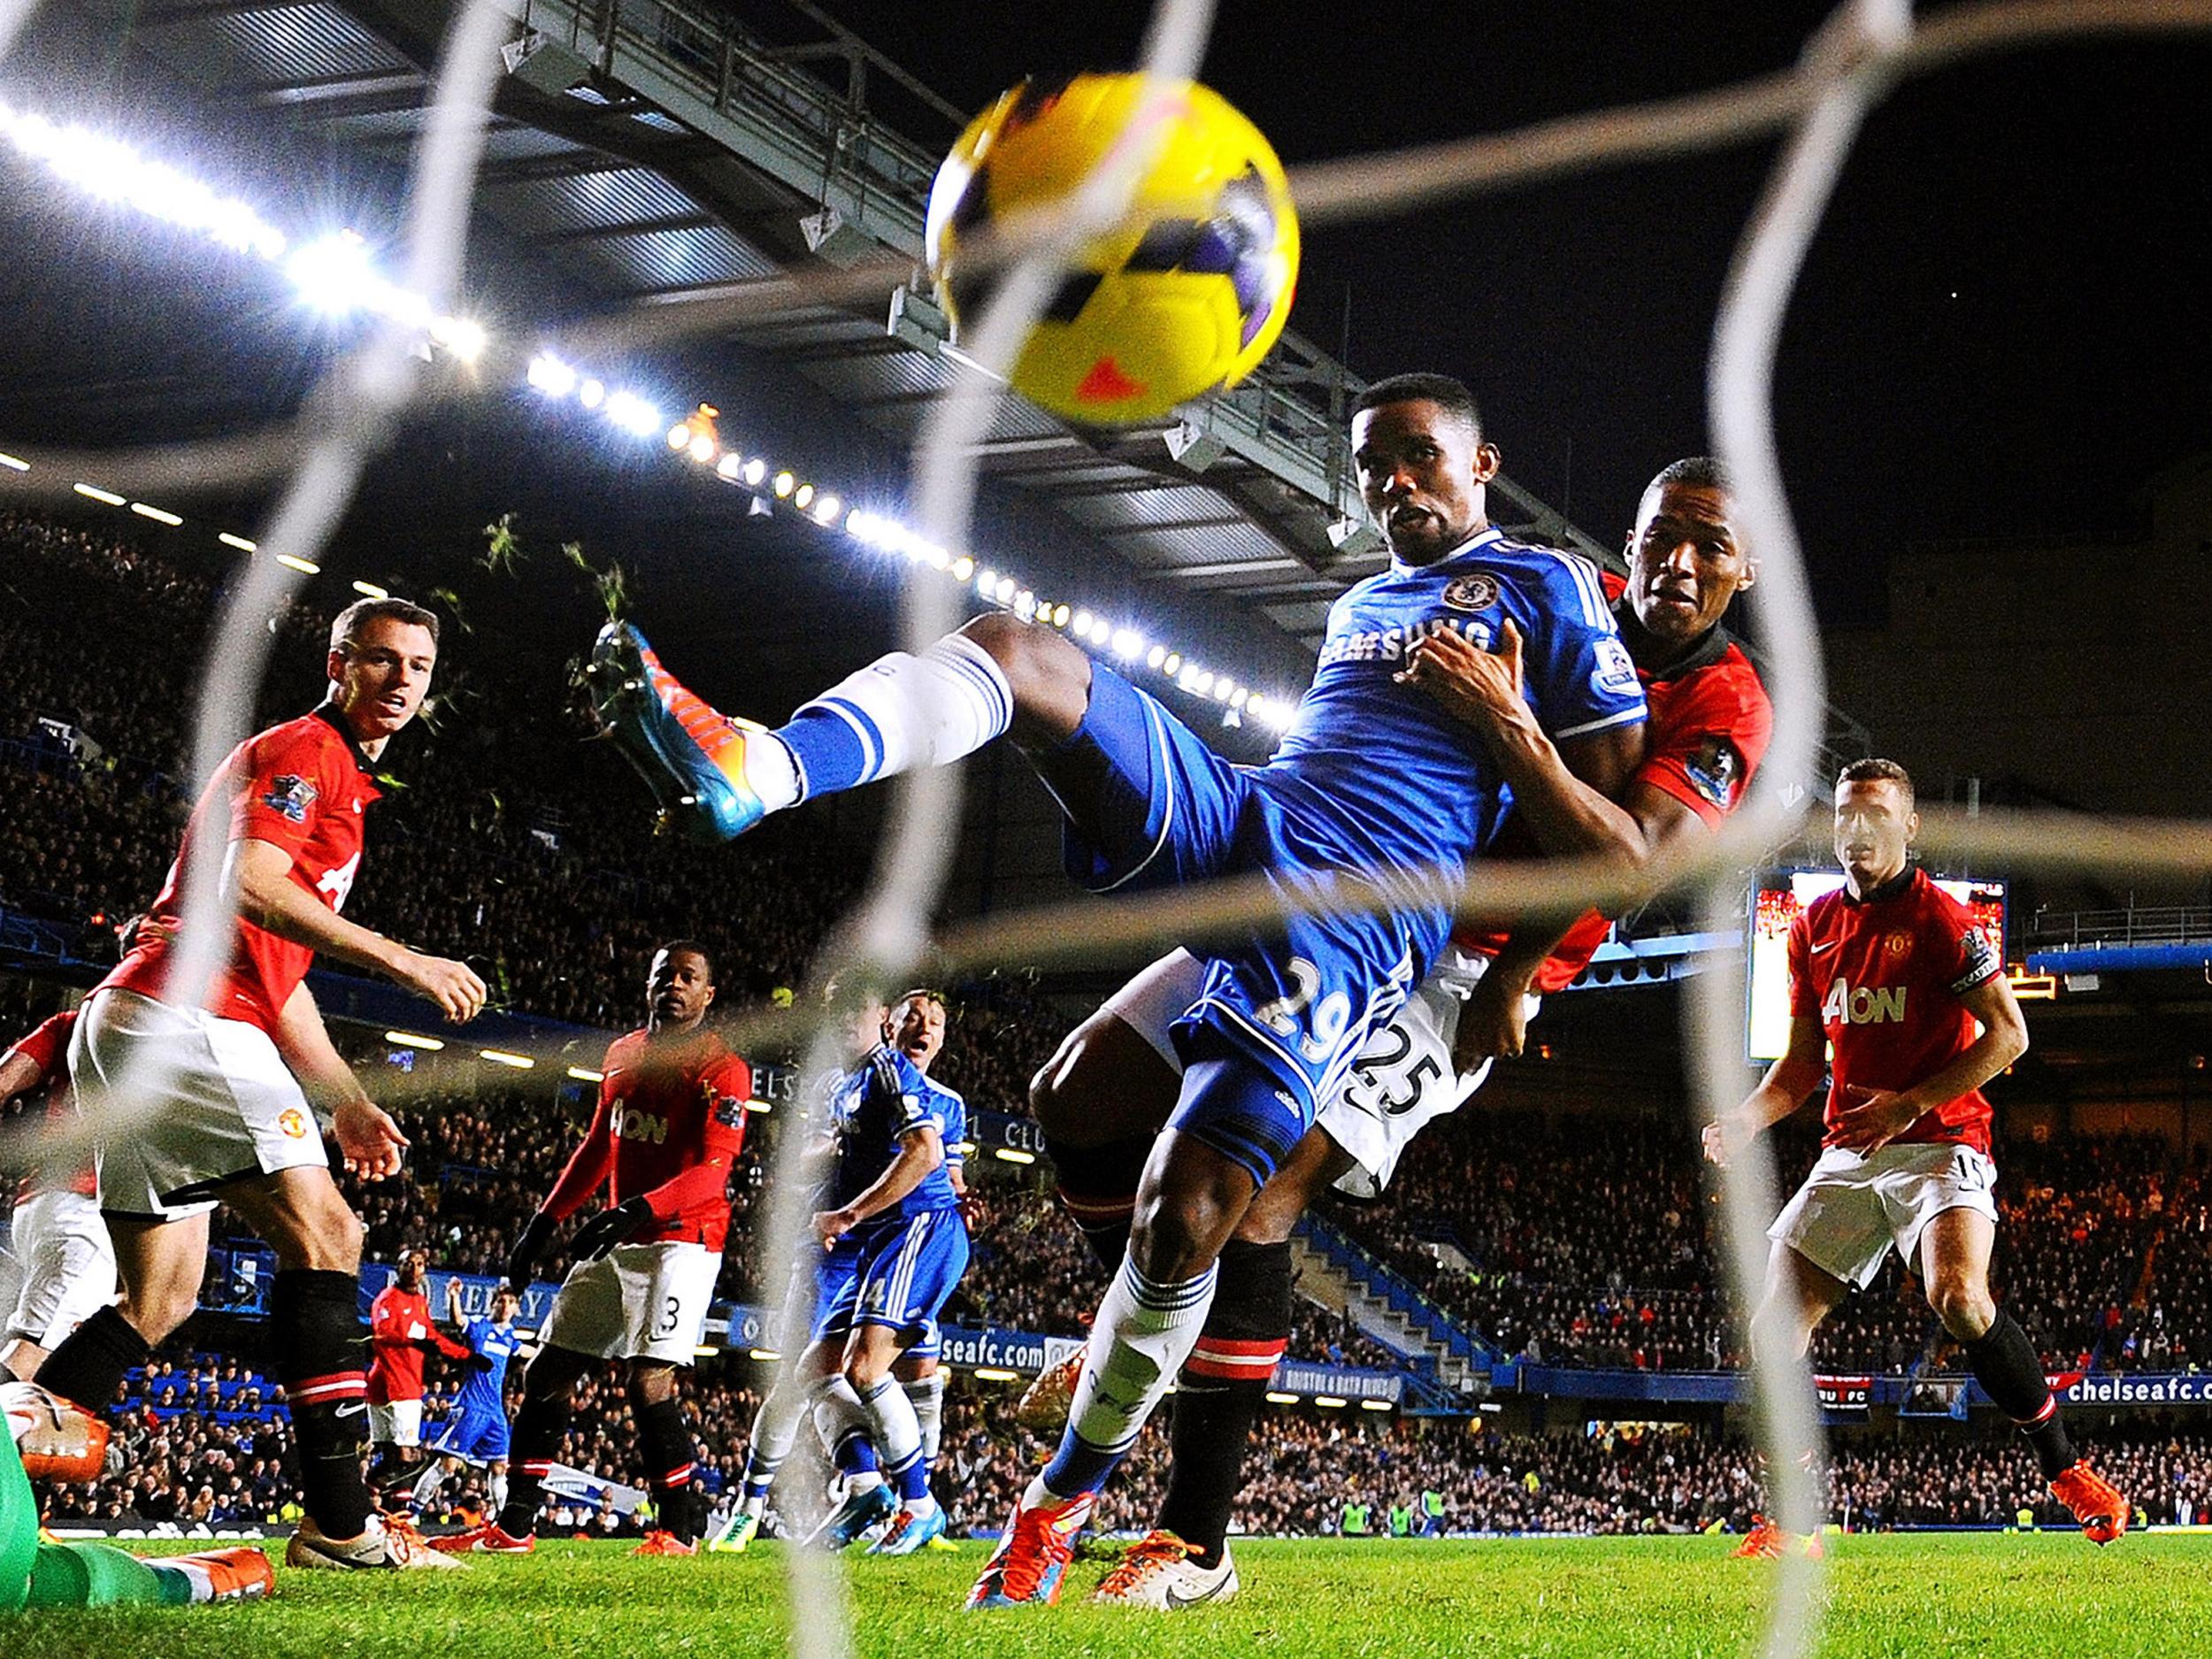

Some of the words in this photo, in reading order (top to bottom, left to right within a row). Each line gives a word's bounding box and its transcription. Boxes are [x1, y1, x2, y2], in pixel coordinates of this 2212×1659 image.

[1320, 618, 1491, 664] AMSG
[1254, 956, 1351, 1064] 29
[1822, 977, 1907, 1025] AON
[1350, 1023, 1443, 1116] 25
[1956, 1154, 1985, 1190] 15
[660, 1296, 680, 1333] 3
